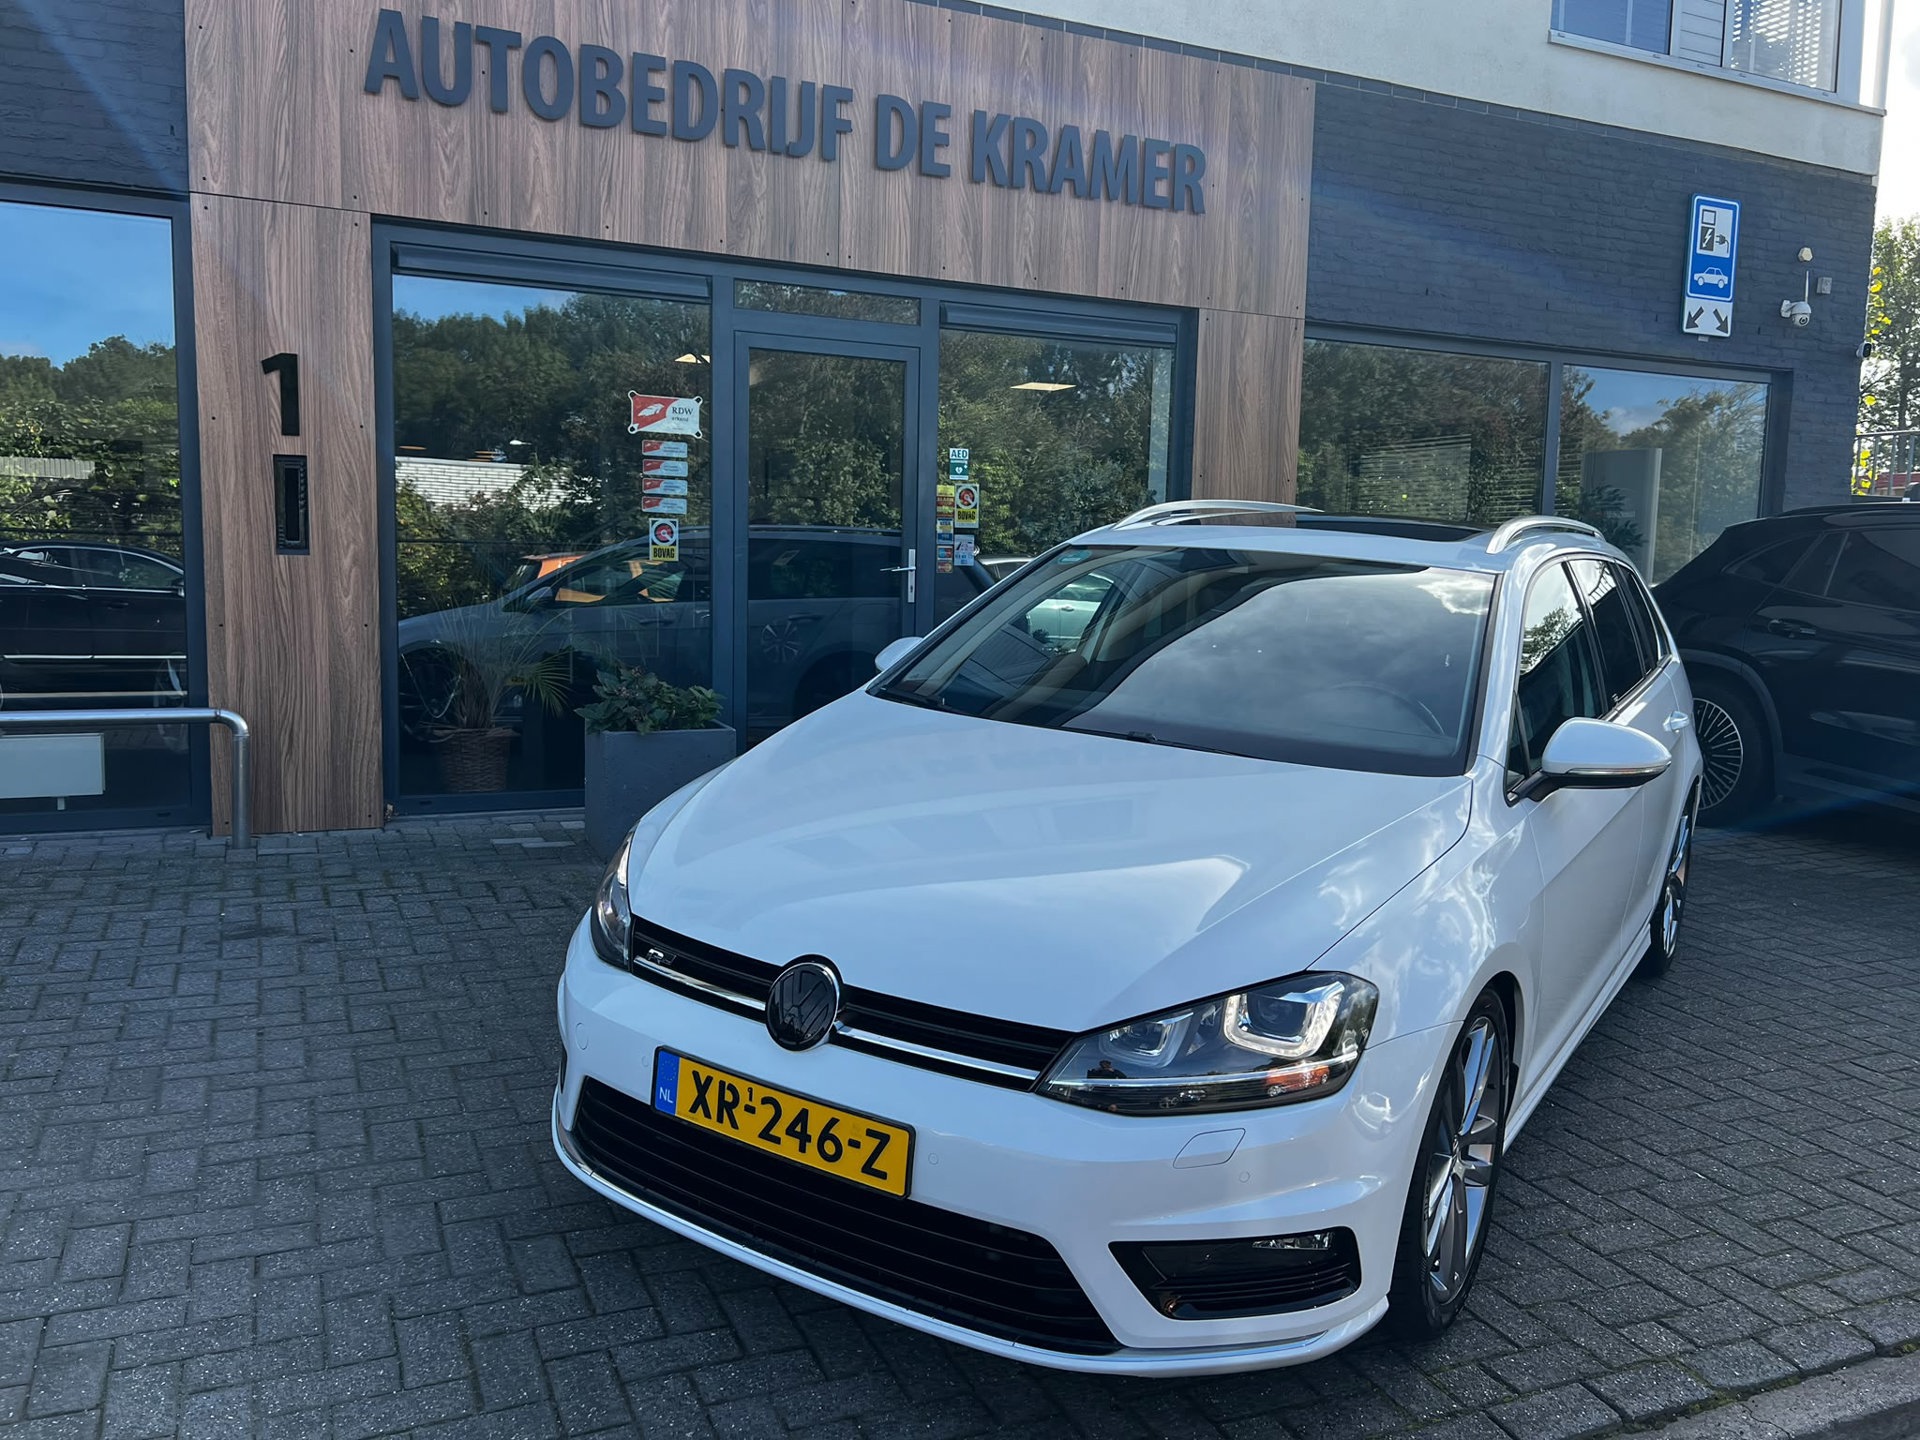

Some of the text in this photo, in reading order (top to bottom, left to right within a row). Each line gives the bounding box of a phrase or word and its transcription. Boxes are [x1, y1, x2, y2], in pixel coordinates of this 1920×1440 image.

[364, 8, 1206, 215] AUTOBEDRIJF DE KRAMER
[261, 352, 301, 437] 1
[672, 406, 694, 415] RDW
[951, 449, 968, 459] AED
[957, 510, 976, 521] BOVAG
[653, 547, 675, 559] BOVAG
[659, 1086, 674, 1104] NL
